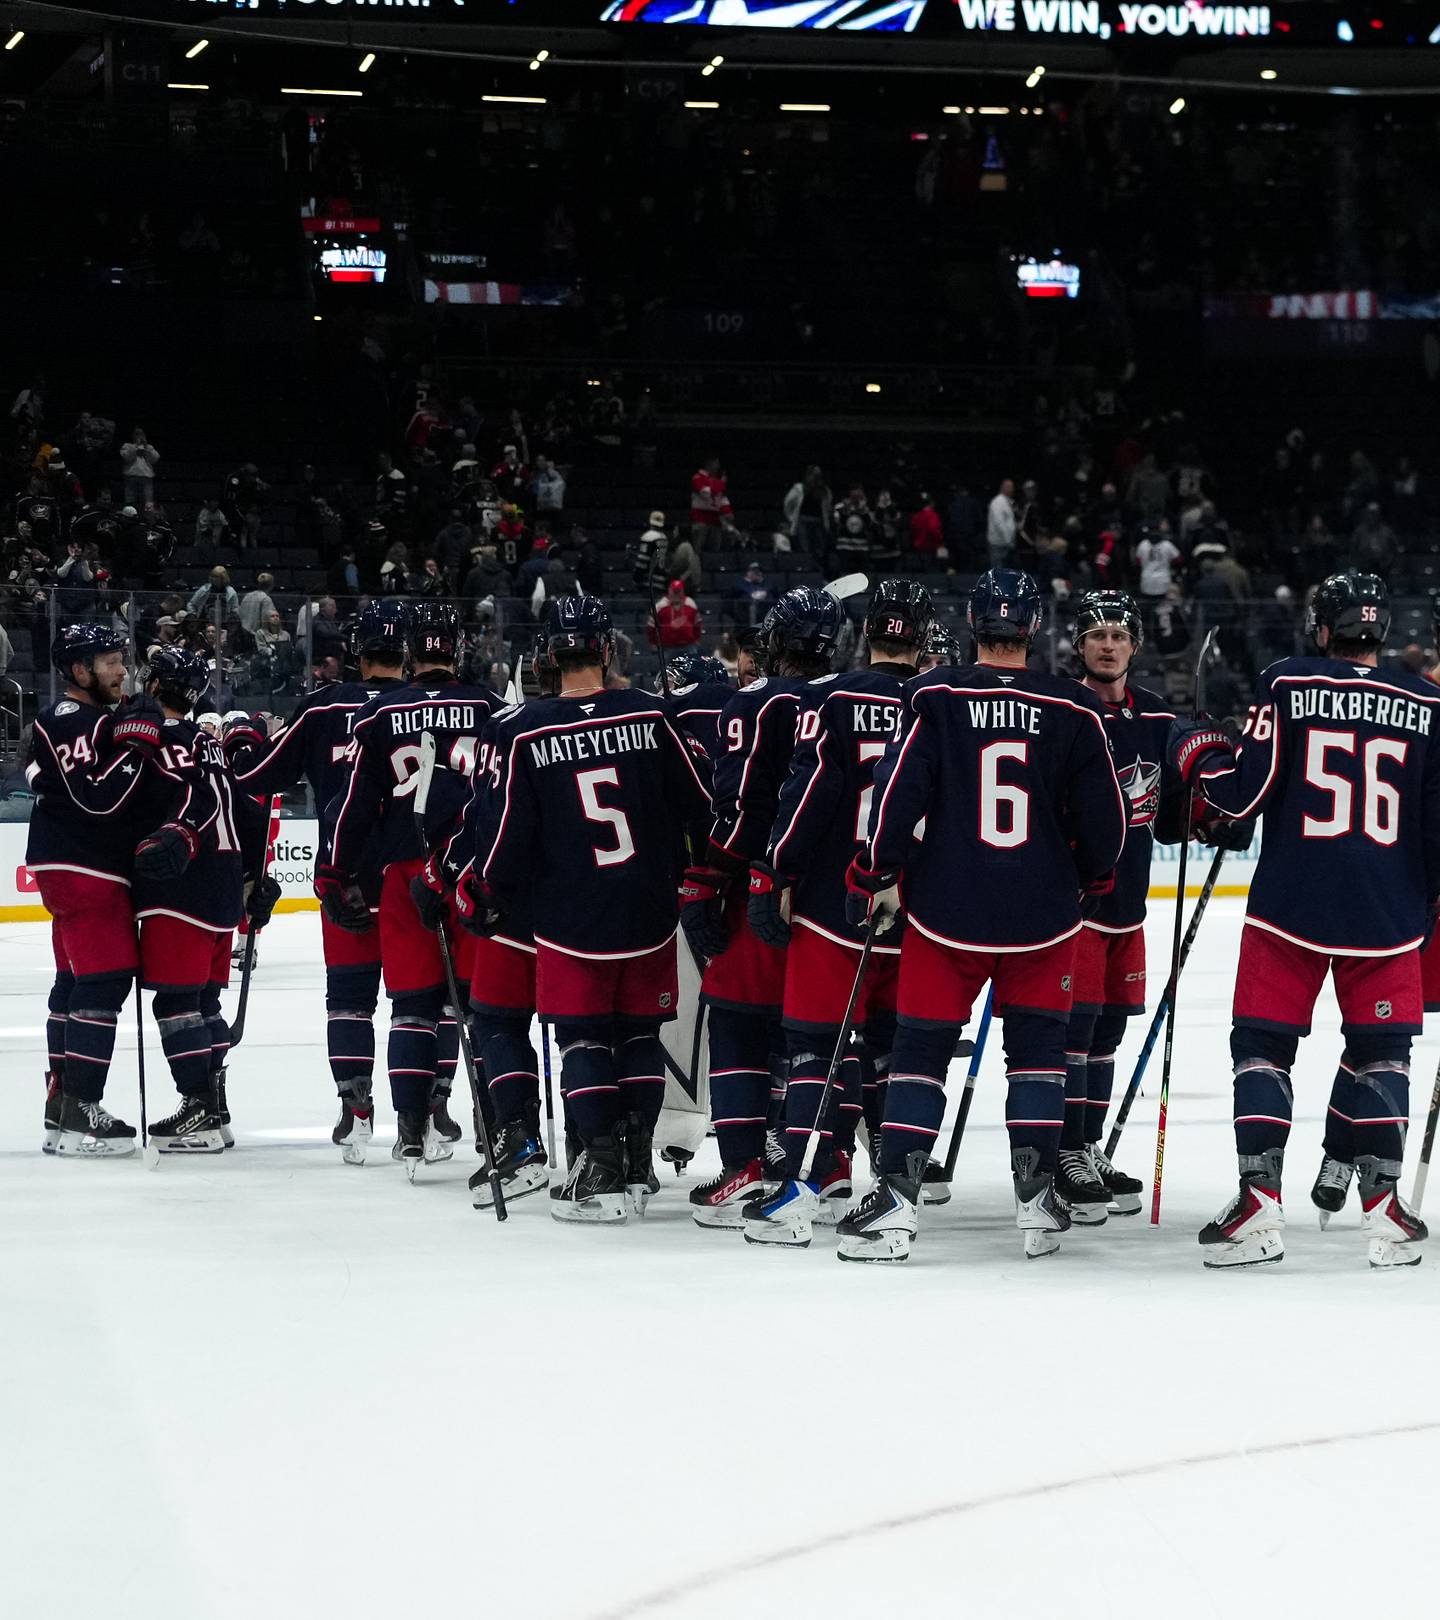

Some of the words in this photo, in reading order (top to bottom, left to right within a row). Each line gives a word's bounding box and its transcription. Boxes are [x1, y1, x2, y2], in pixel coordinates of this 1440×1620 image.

[958, 0, 1015, 31] WE
[1021, 0, 1111, 40] WIN,
[702, 312, 745, 334] 109
[1000, 602, 1008, 618] 6
[1361, 606, 1377, 622] 56
[383, 623, 394, 636] 71
[568, 633, 576, 647] 5
[887, 618, 903, 634] 20
[426, 636, 441, 650] 84
[390, 705, 475, 736] RICHARD
[967, 700, 1043, 735] WHITE
[1290, 688, 1433, 737] BUCKBERGER
[529, 722, 659, 770] MATEYCHUK
[727, 718, 744, 753] 9
[56, 736, 92, 774] 24
[159, 744, 195, 770] 12
[977, 739, 1031, 849] 6
[1302, 727, 1410, 848] 56
[575, 766, 638, 869] 5
[271, 840, 313, 861] tics
[268, 867, 314, 883] book
[175, 1109, 206, 1135] CCM
[711, 1172, 750, 1204] CCM
